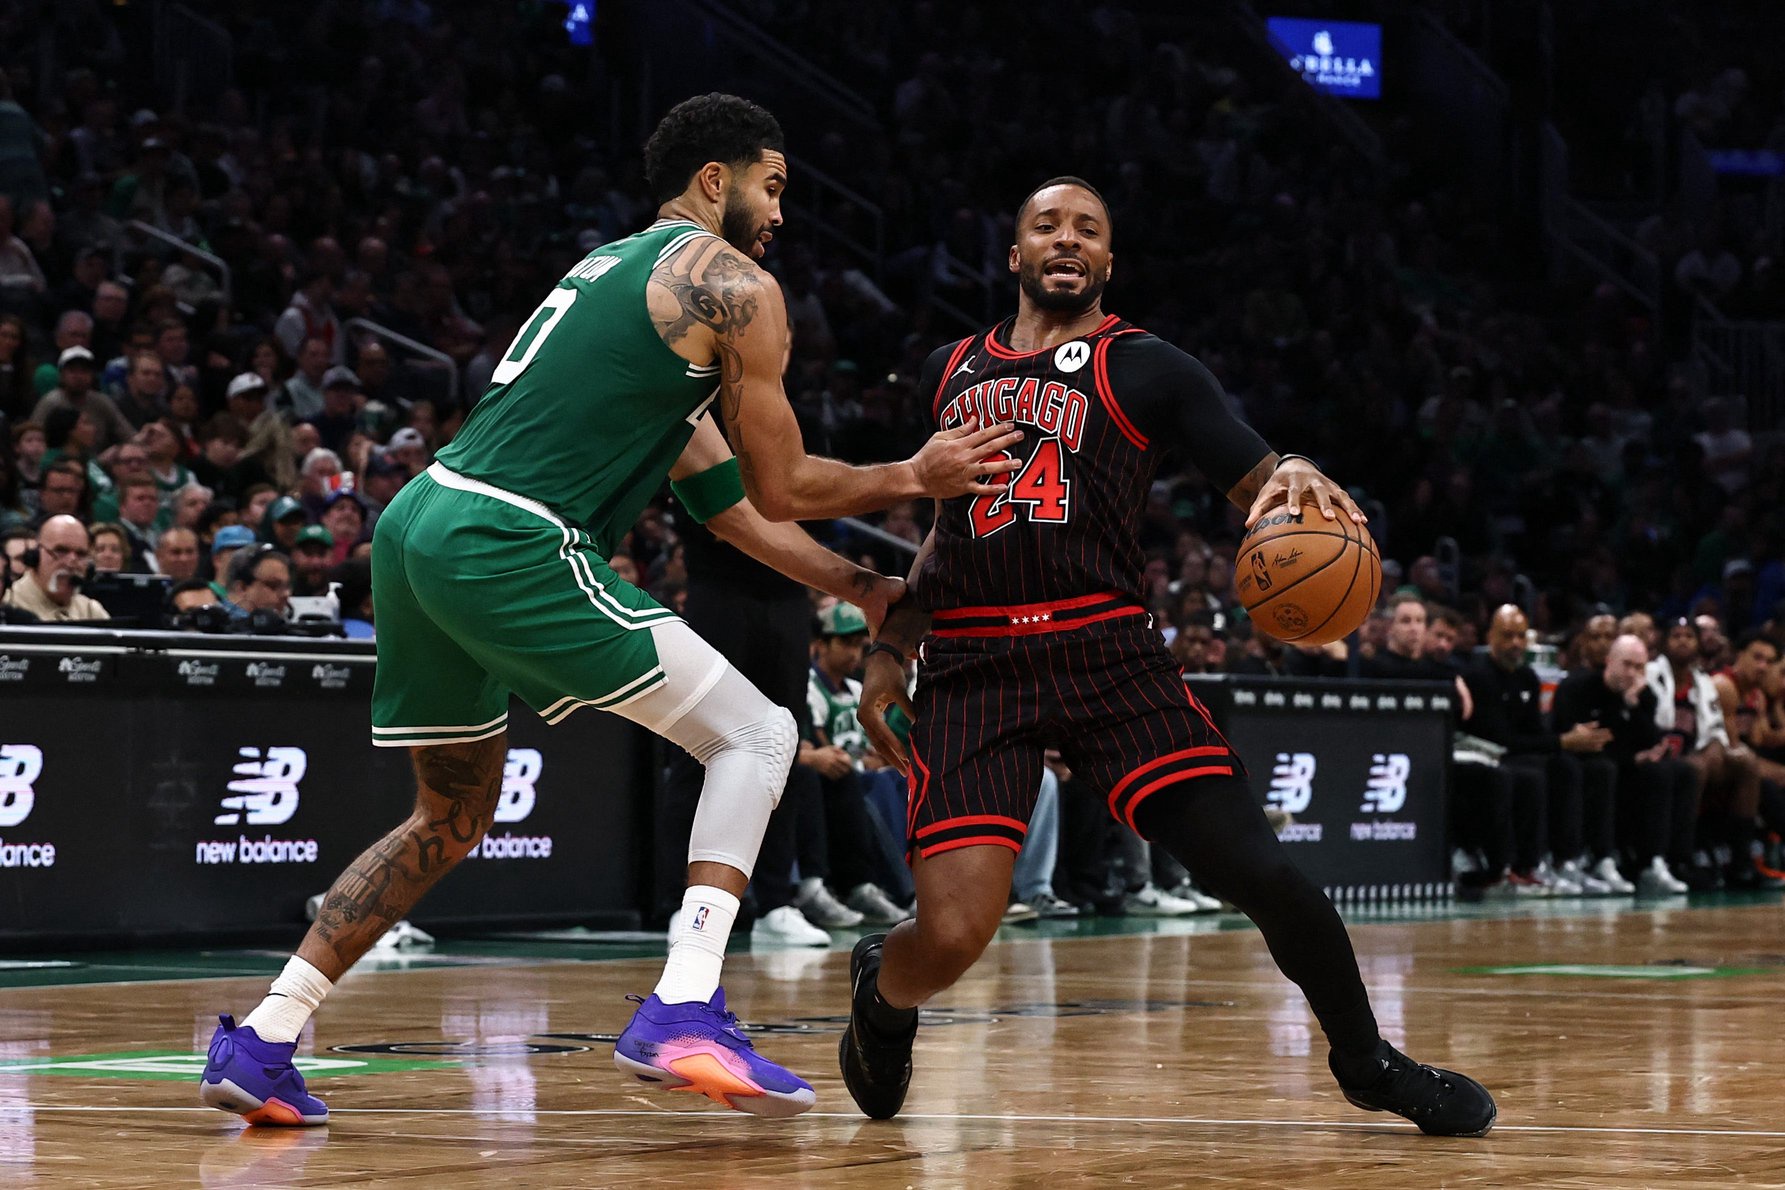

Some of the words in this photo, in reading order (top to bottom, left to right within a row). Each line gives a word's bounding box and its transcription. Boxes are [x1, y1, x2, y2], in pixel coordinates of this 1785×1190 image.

[562, 255, 623, 283] ATUM
[491, 287, 578, 385] 0
[940, 377, 1088, 453] CHICAGO
[968, 436, 1070, 539] 24
[196, 840, 237, 865] new
[239, 834, 318, 864] balance
[482, 831, 552, 859] balance
